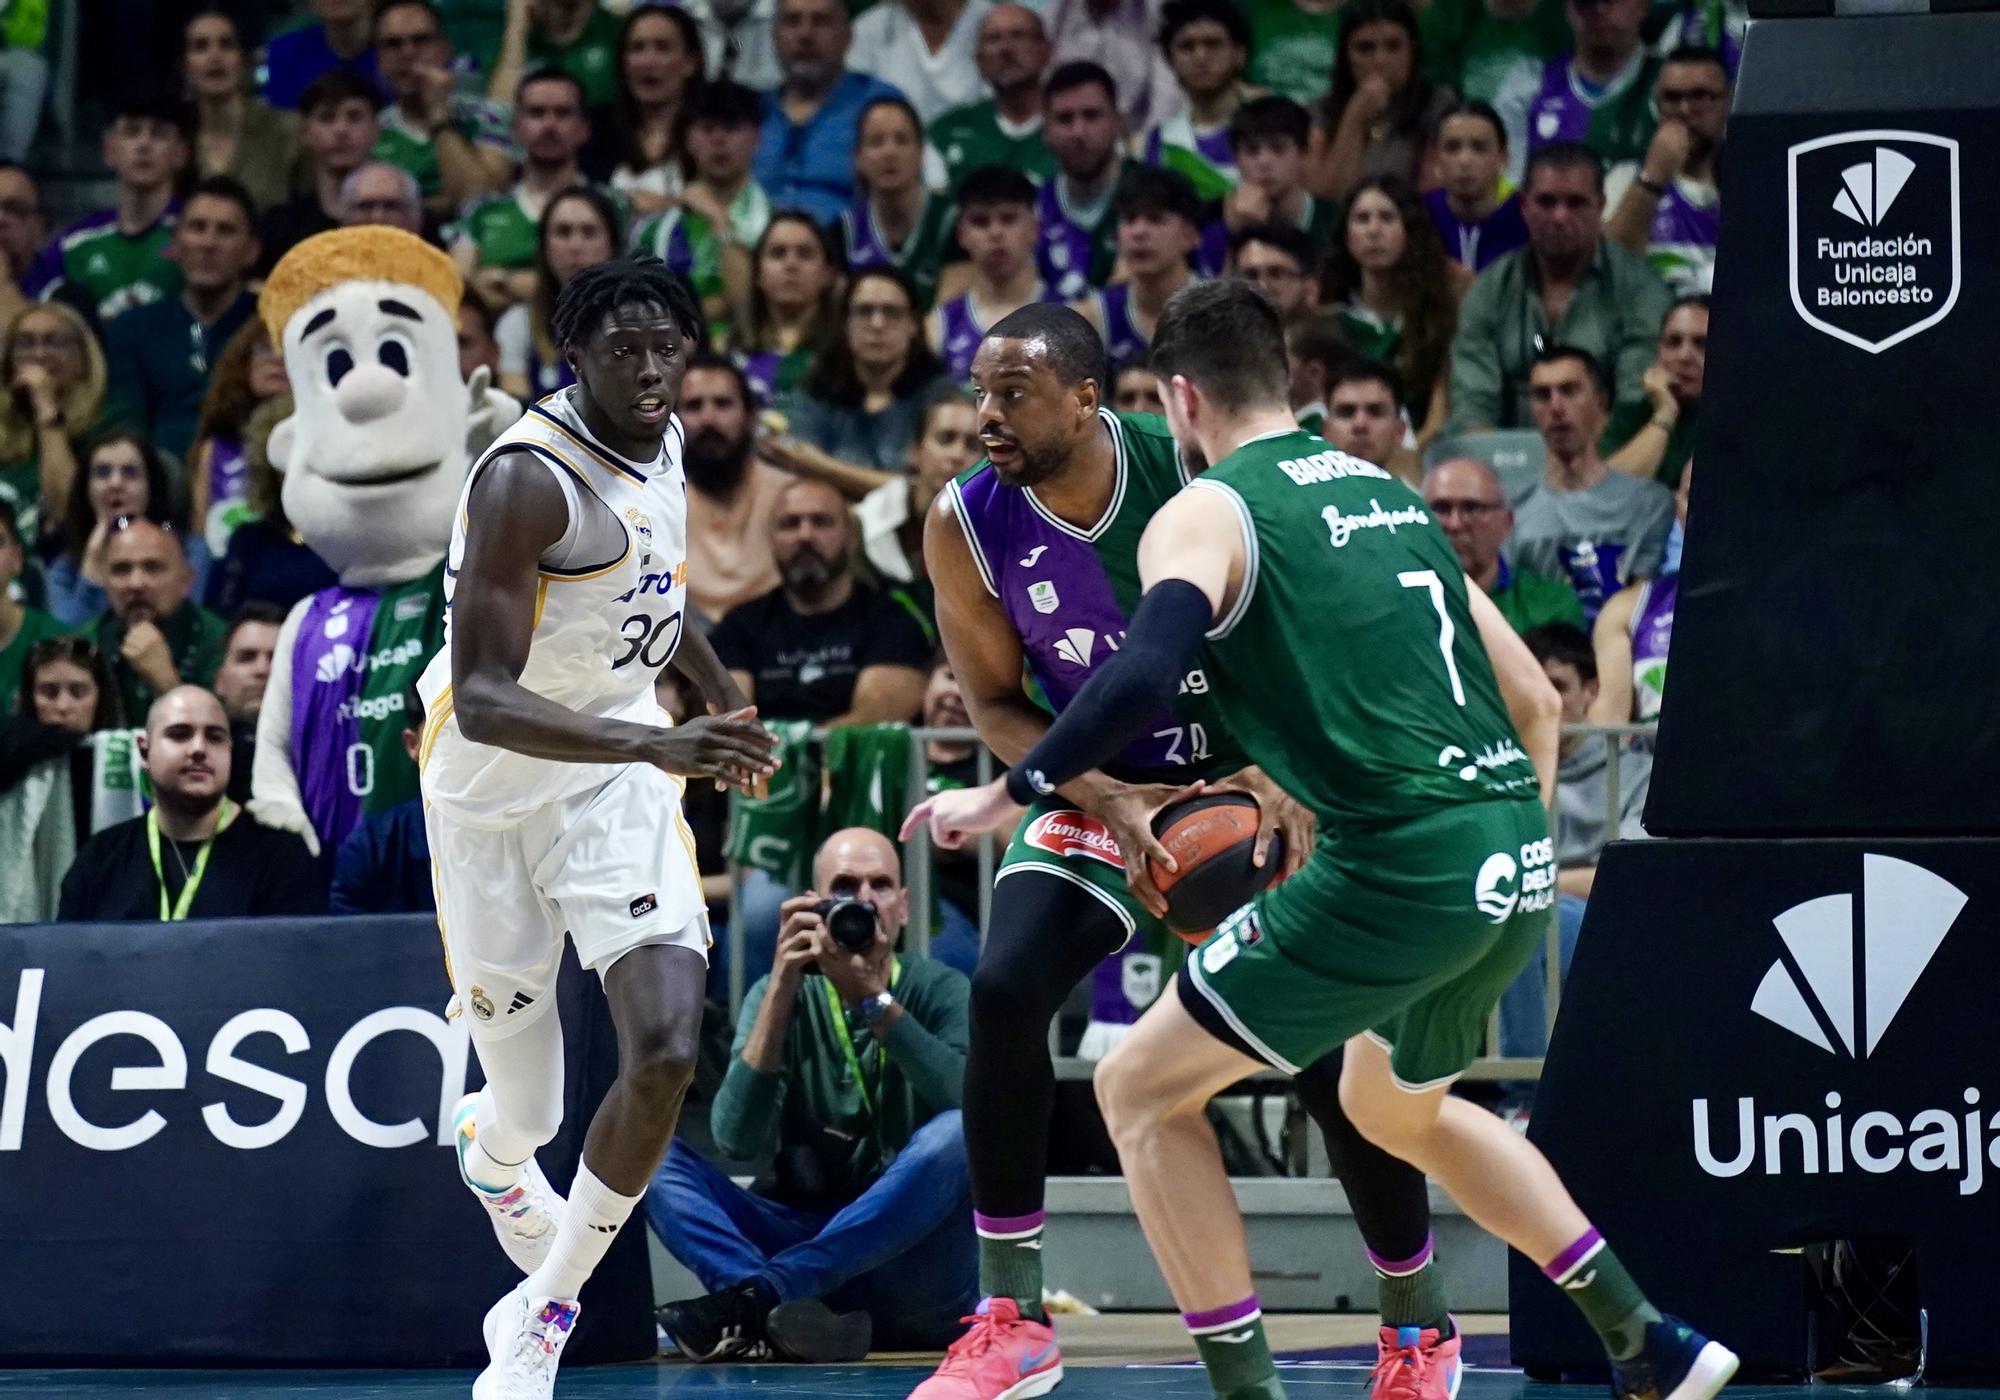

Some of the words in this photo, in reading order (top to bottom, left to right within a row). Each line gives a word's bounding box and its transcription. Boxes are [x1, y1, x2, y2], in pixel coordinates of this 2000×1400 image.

[1817, 232, 1932, 259] Fundación
[1834, 262, 1917, 287] Unicaja
[1817, 285, 1934, 306] Baloncesto
[612, 611, 681, 670] 30
[1396, 569, 1467, 707] 7
[1036, 813, 1121, 857] famades
[1520, 837, 1554, 869] COS
[632, 901, 652, 916] acb
[1693, 1087, 2000, 1196] Unicaj
